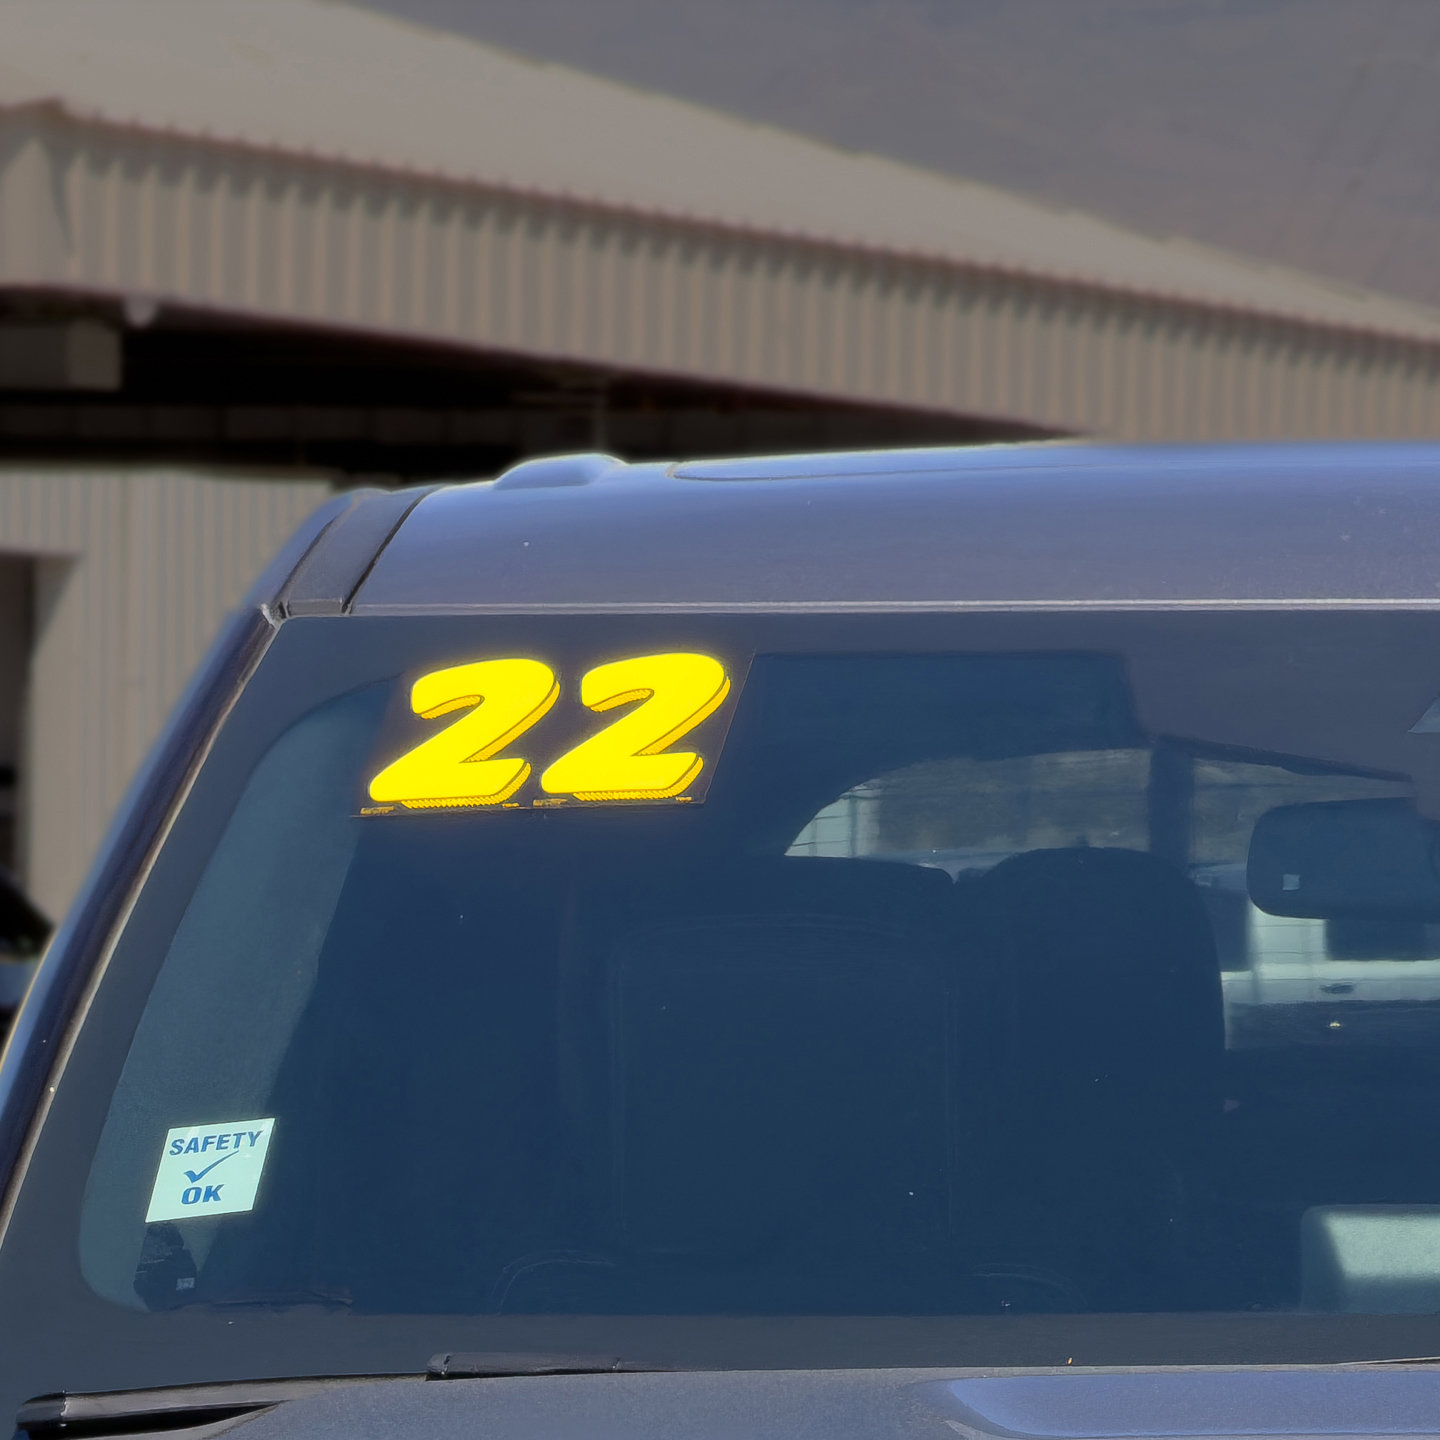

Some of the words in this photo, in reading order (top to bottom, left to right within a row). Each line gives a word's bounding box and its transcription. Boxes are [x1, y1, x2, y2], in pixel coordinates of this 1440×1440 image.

[369, 652, 732, 809] 22
[169, 1130, 264, 1156] SAFETY
[181, 1184, 225, 1205] OK
